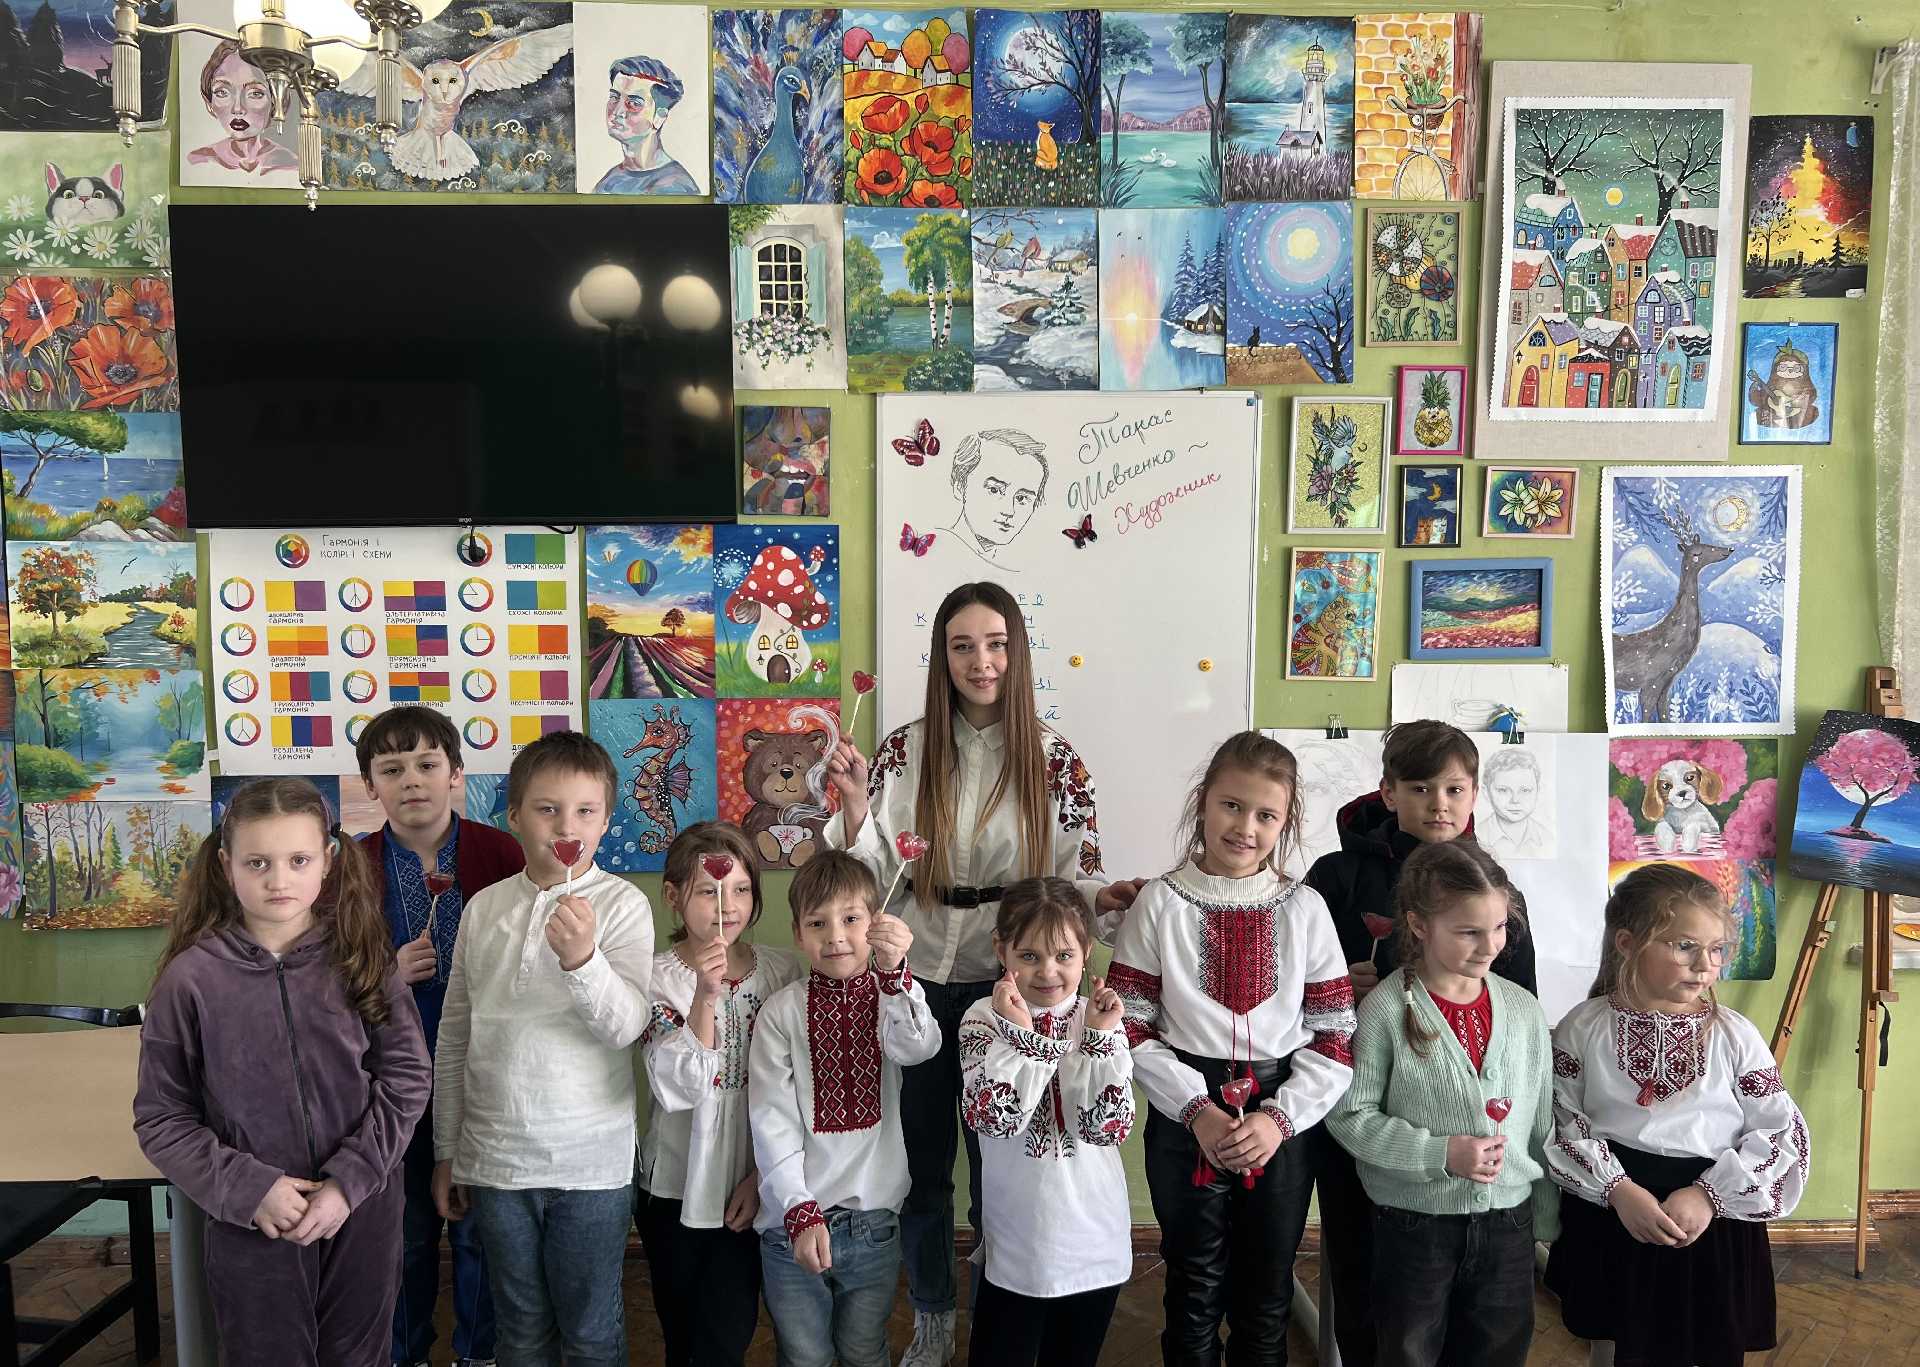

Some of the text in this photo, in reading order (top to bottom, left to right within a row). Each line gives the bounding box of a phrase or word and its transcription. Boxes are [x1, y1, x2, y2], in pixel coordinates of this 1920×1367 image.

[1078, 409, 1173, 465] Тарас
[1067, 449, 1175, 512] Шевченко
[1115, 472, 1222, 535] Художник
